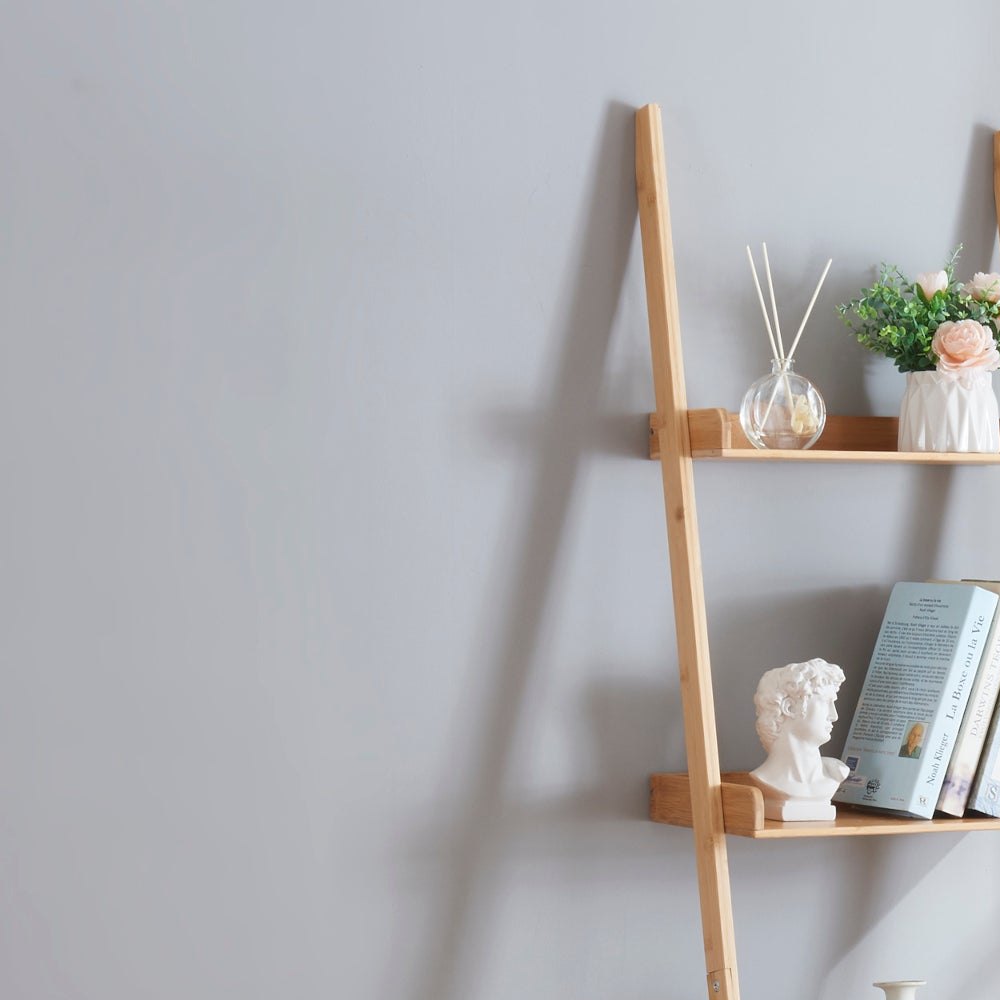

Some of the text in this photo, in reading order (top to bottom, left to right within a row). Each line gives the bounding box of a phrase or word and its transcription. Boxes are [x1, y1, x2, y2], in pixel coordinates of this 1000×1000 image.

[946, 615, 985, 720] La Boxe ou la Vie
[926, 732, 949, 786] Noah Klieger
